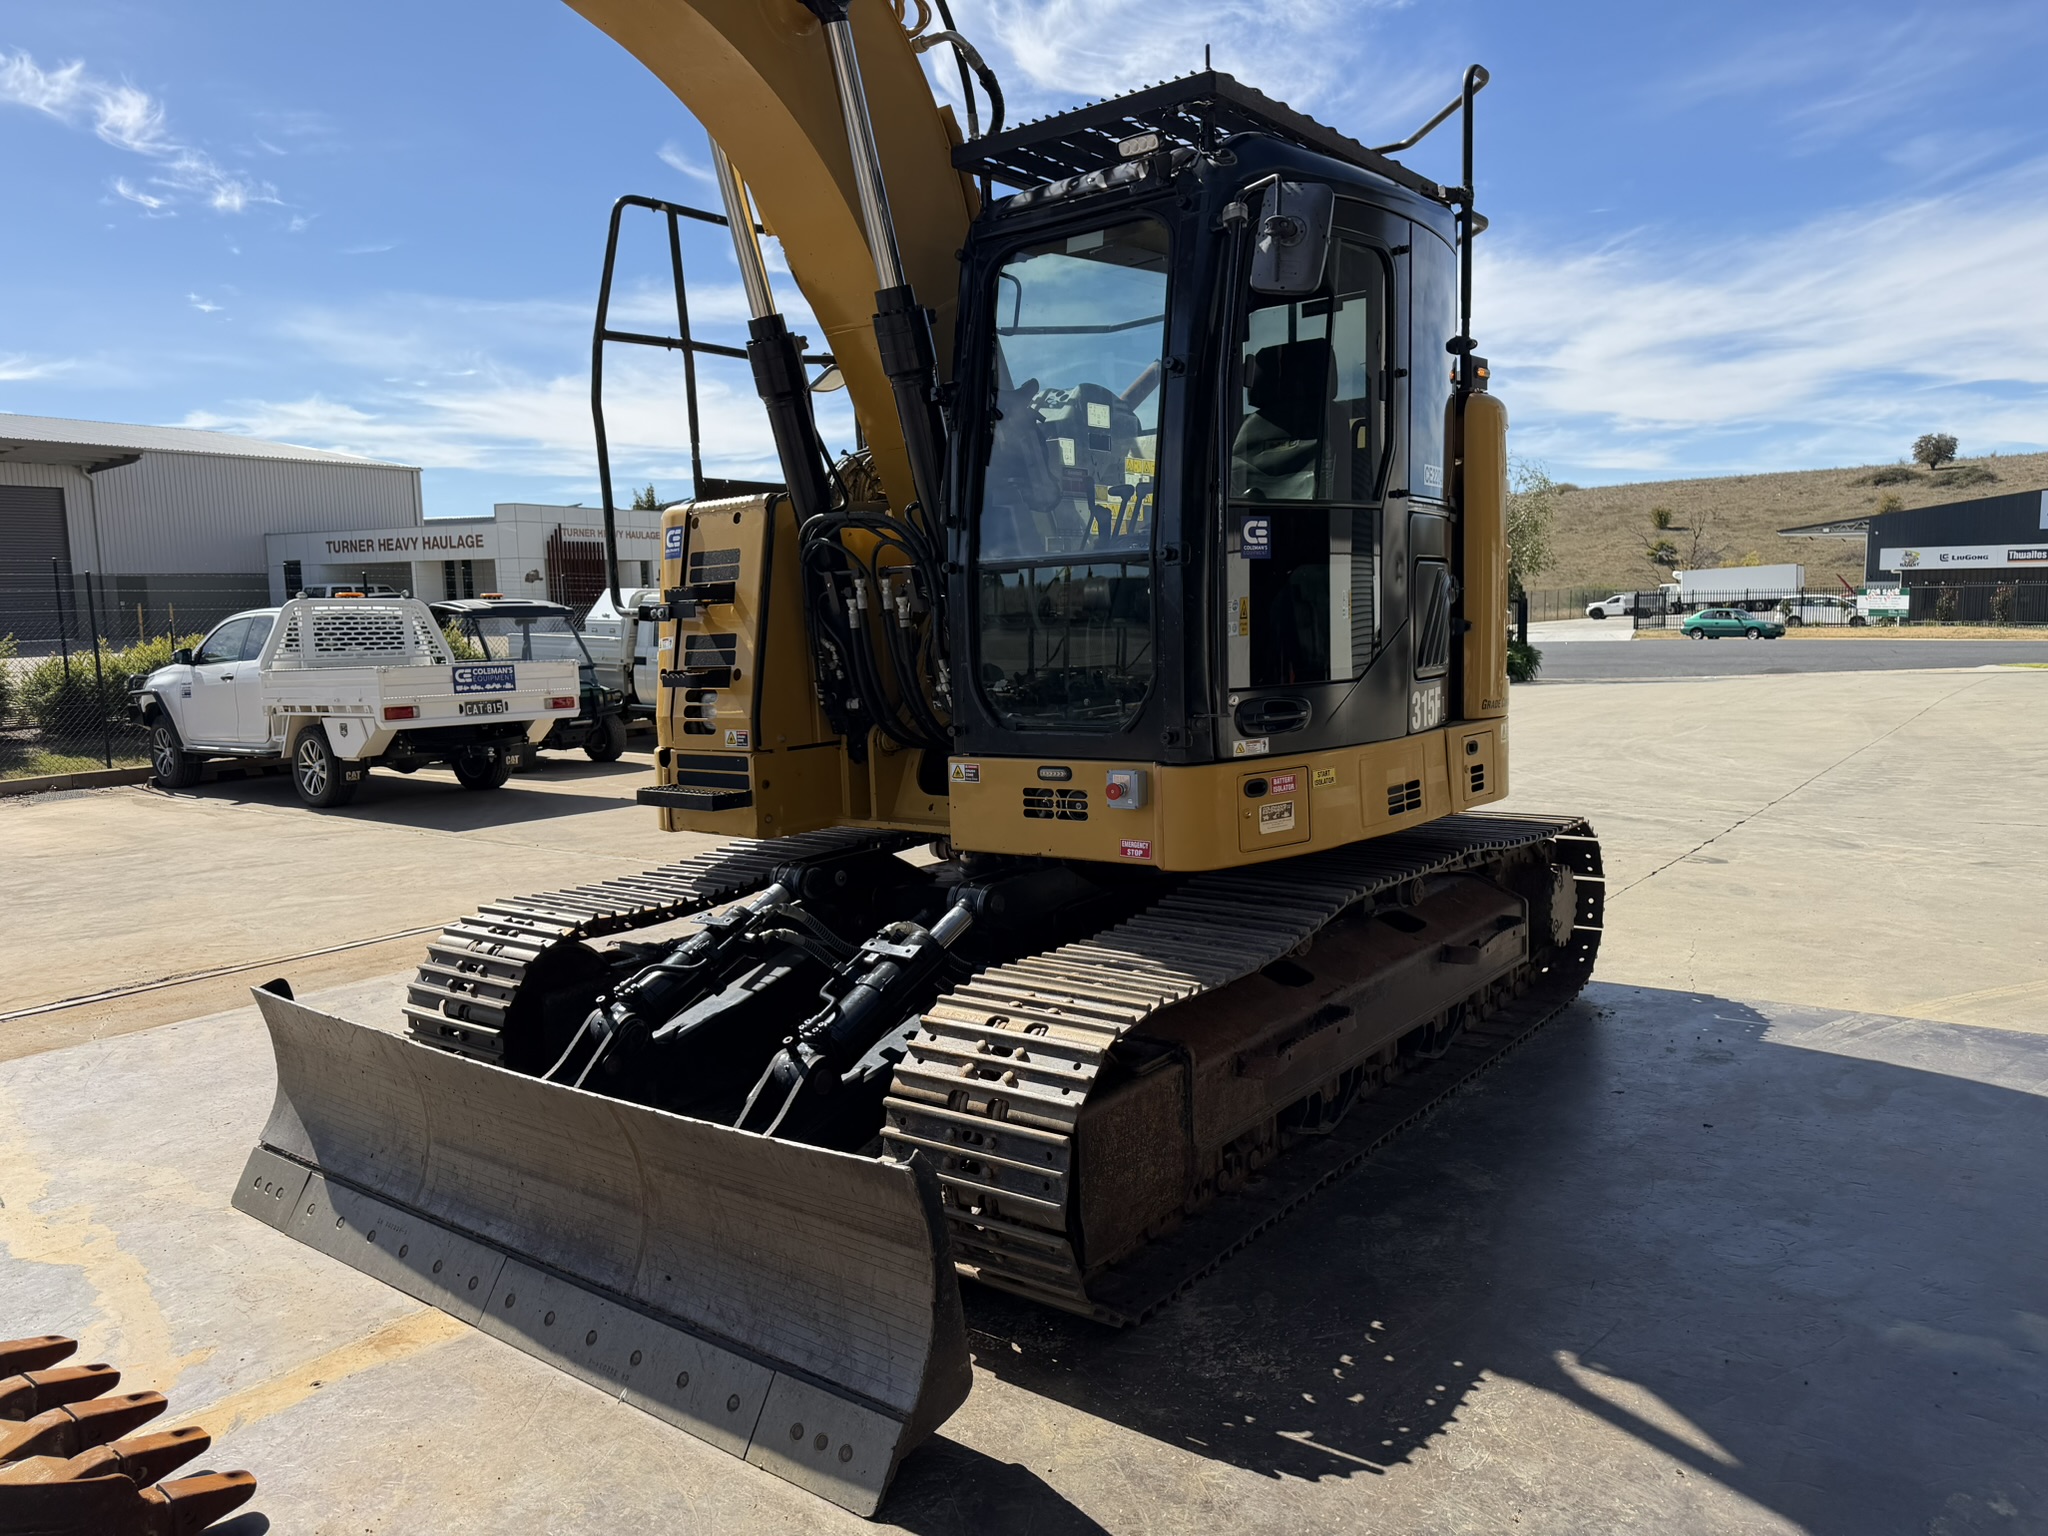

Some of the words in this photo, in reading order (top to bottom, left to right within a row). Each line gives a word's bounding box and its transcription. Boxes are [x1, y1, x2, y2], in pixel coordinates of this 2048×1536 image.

[561, 528, 596, 538] TURNER
[625, 530, 661, 540] HAULAGE
[326, 539, 374, 554] TURNER
[378, 537, 419, 552] HEAVY
[422, 534, 484, 550] HAULAGE
[472, 666, 514, 675] COLEMAN'S
[472, 673, 514, 682] EQUIPMENT
[1481, 699, 1501, 710] GRADE
[506, 754, 520, 765] CAT
[345, 770, 361, 781] CAT
[1317, 769, 1331, 778] START
[1273, 776, 1294, 785] BATTERY
[1314, 776, 1335, 785] ISOLATOR
[1273, 783, 1295, 793] ISOLATOR
[1121, 840, 1149, 849] EMERGENCY
[1127, 848, 1143, 857] STOP
